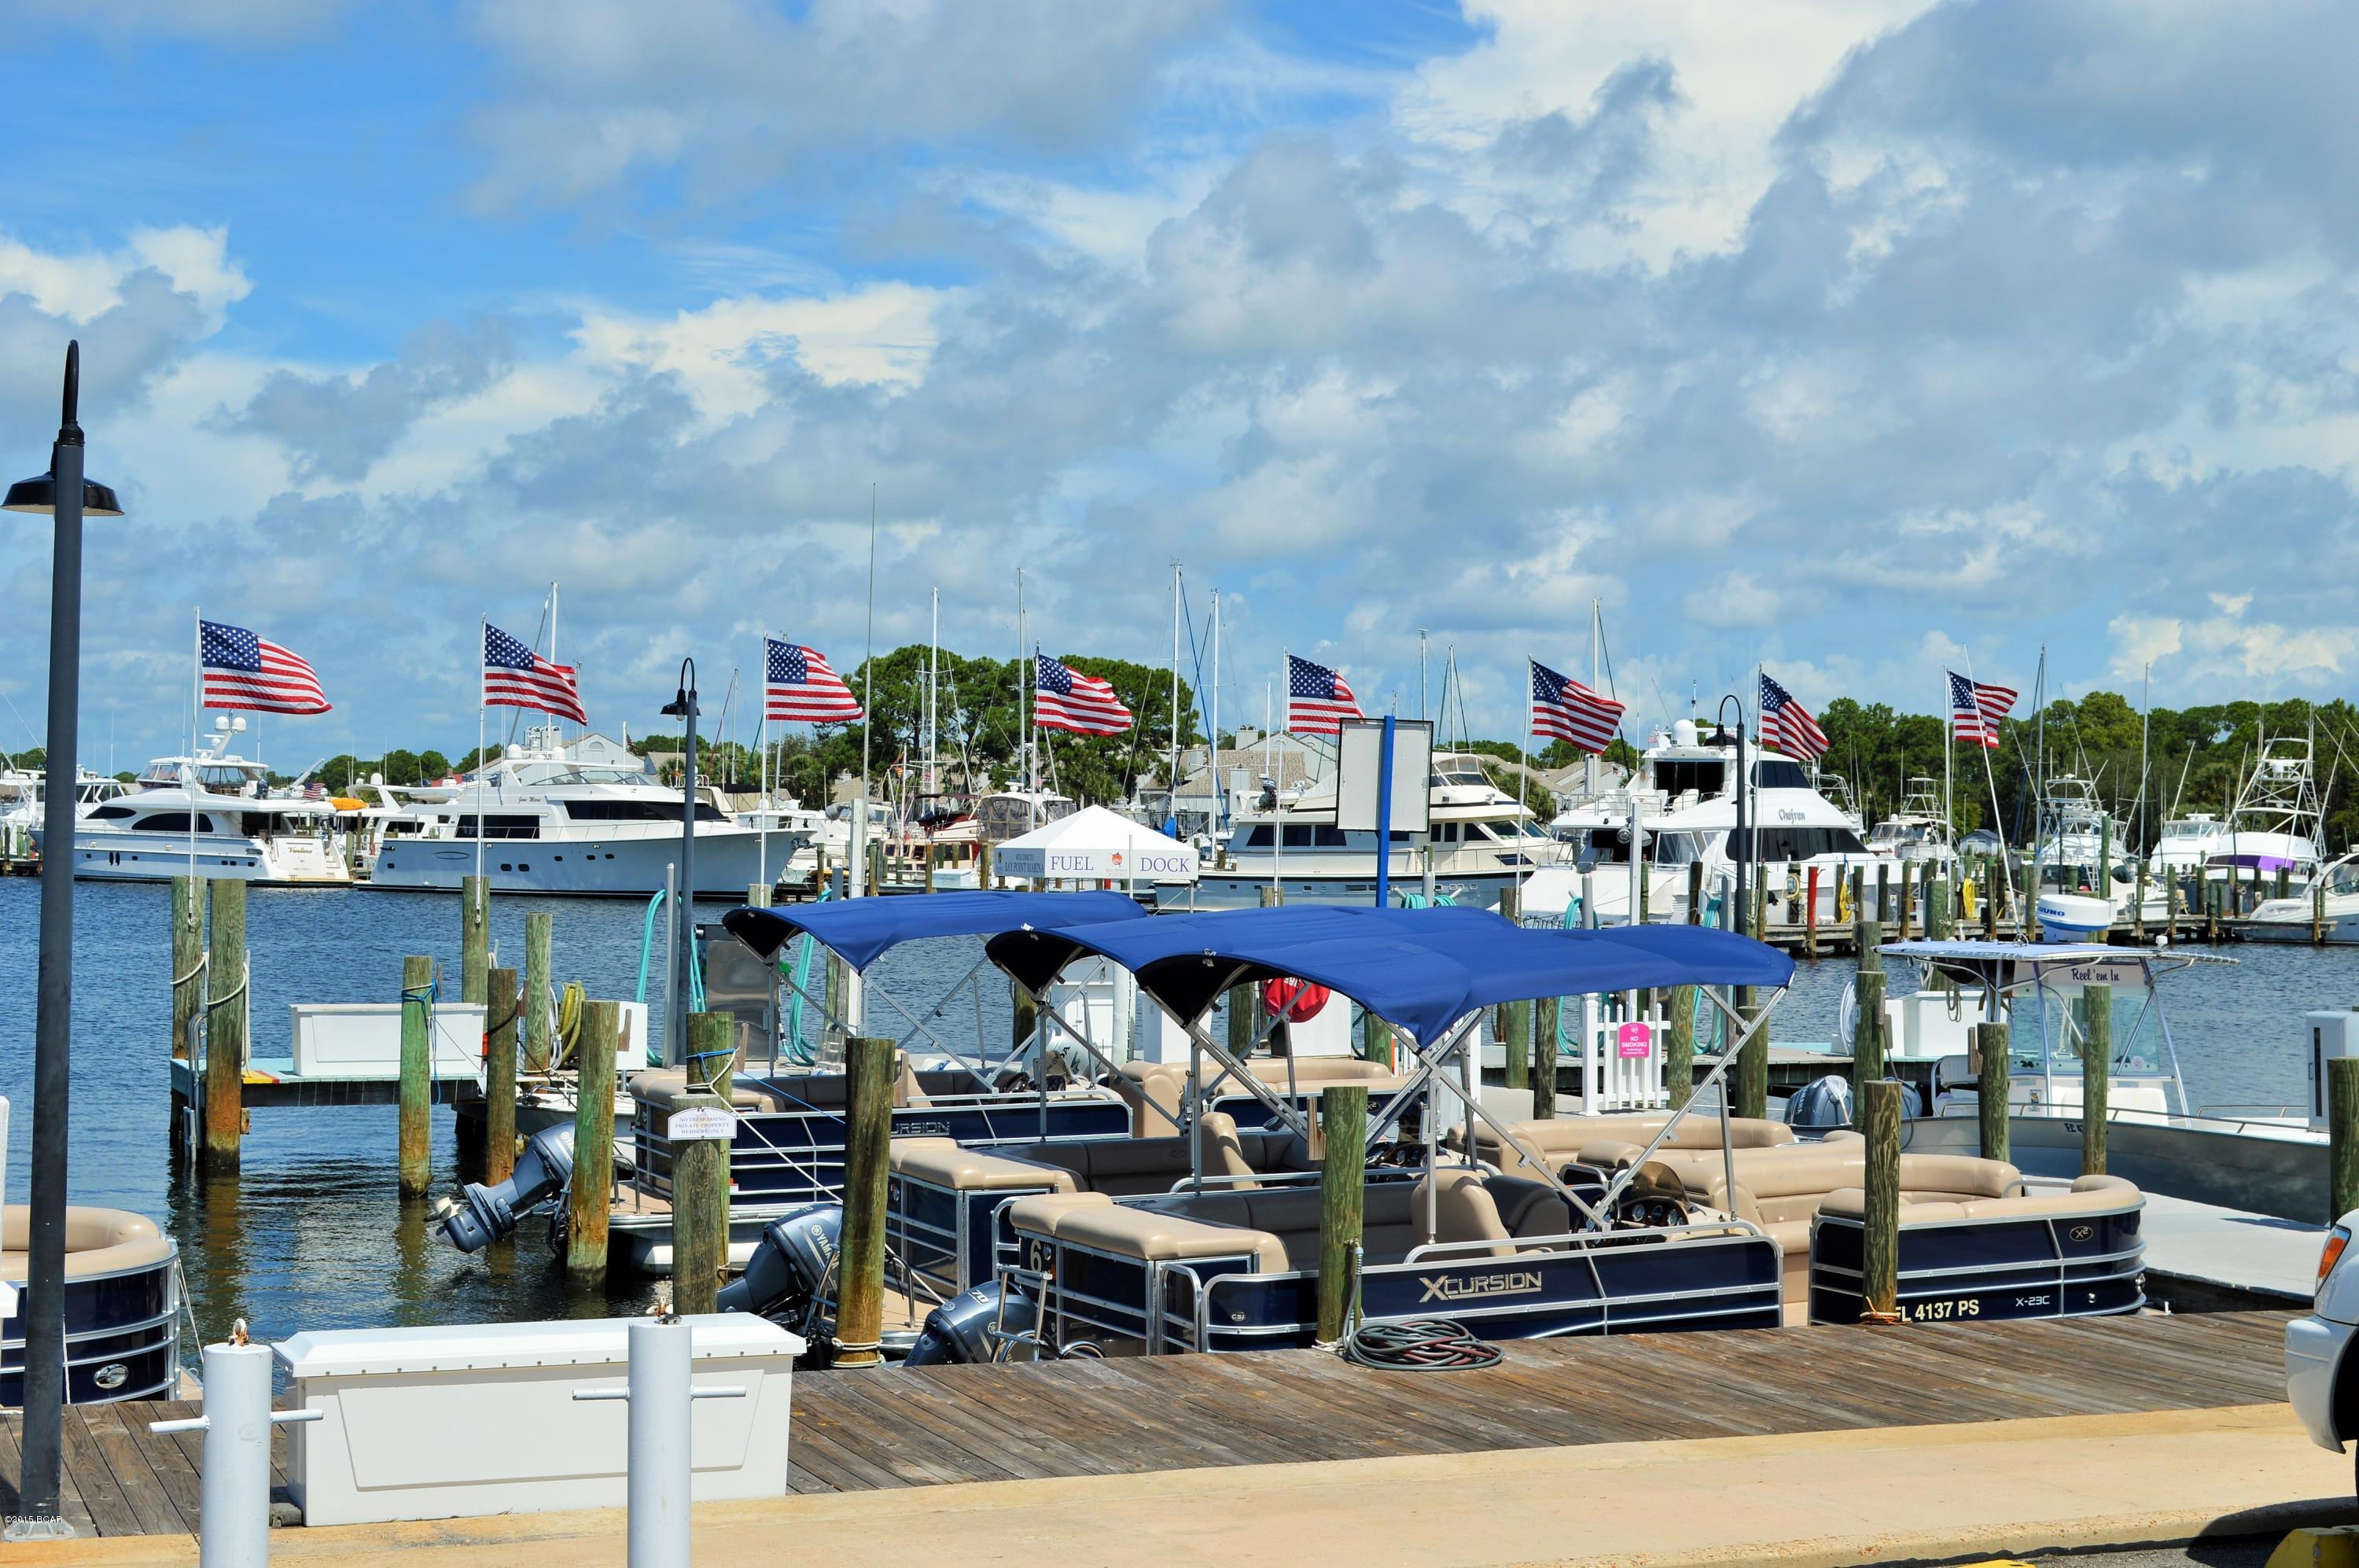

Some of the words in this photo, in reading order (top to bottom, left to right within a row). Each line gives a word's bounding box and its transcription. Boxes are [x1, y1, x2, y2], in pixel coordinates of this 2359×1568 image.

[1004, 862, 1013, 873] BAY
[1014, 862, 1026, 873] POINT
[1026, 863, 1045, 873] MARINA
[1050, 856, 1094, 870] FUEL
[1140, 857, 1191, 872] DOCK
[2071, 968, 2091, 981] Reel
[2111, 969, 2119, 981] In
[1030, 1239, 1043, 1273] 6
[1418, 1271, 1542, 1303] XCURSION
[969, 1289, 990, 1305] 70
[2015, 1295, 2050, 1307] X-23C
[1915, 1301, 1953, 1320] 4137
[1958, 1299, 1979, 1316] PS
